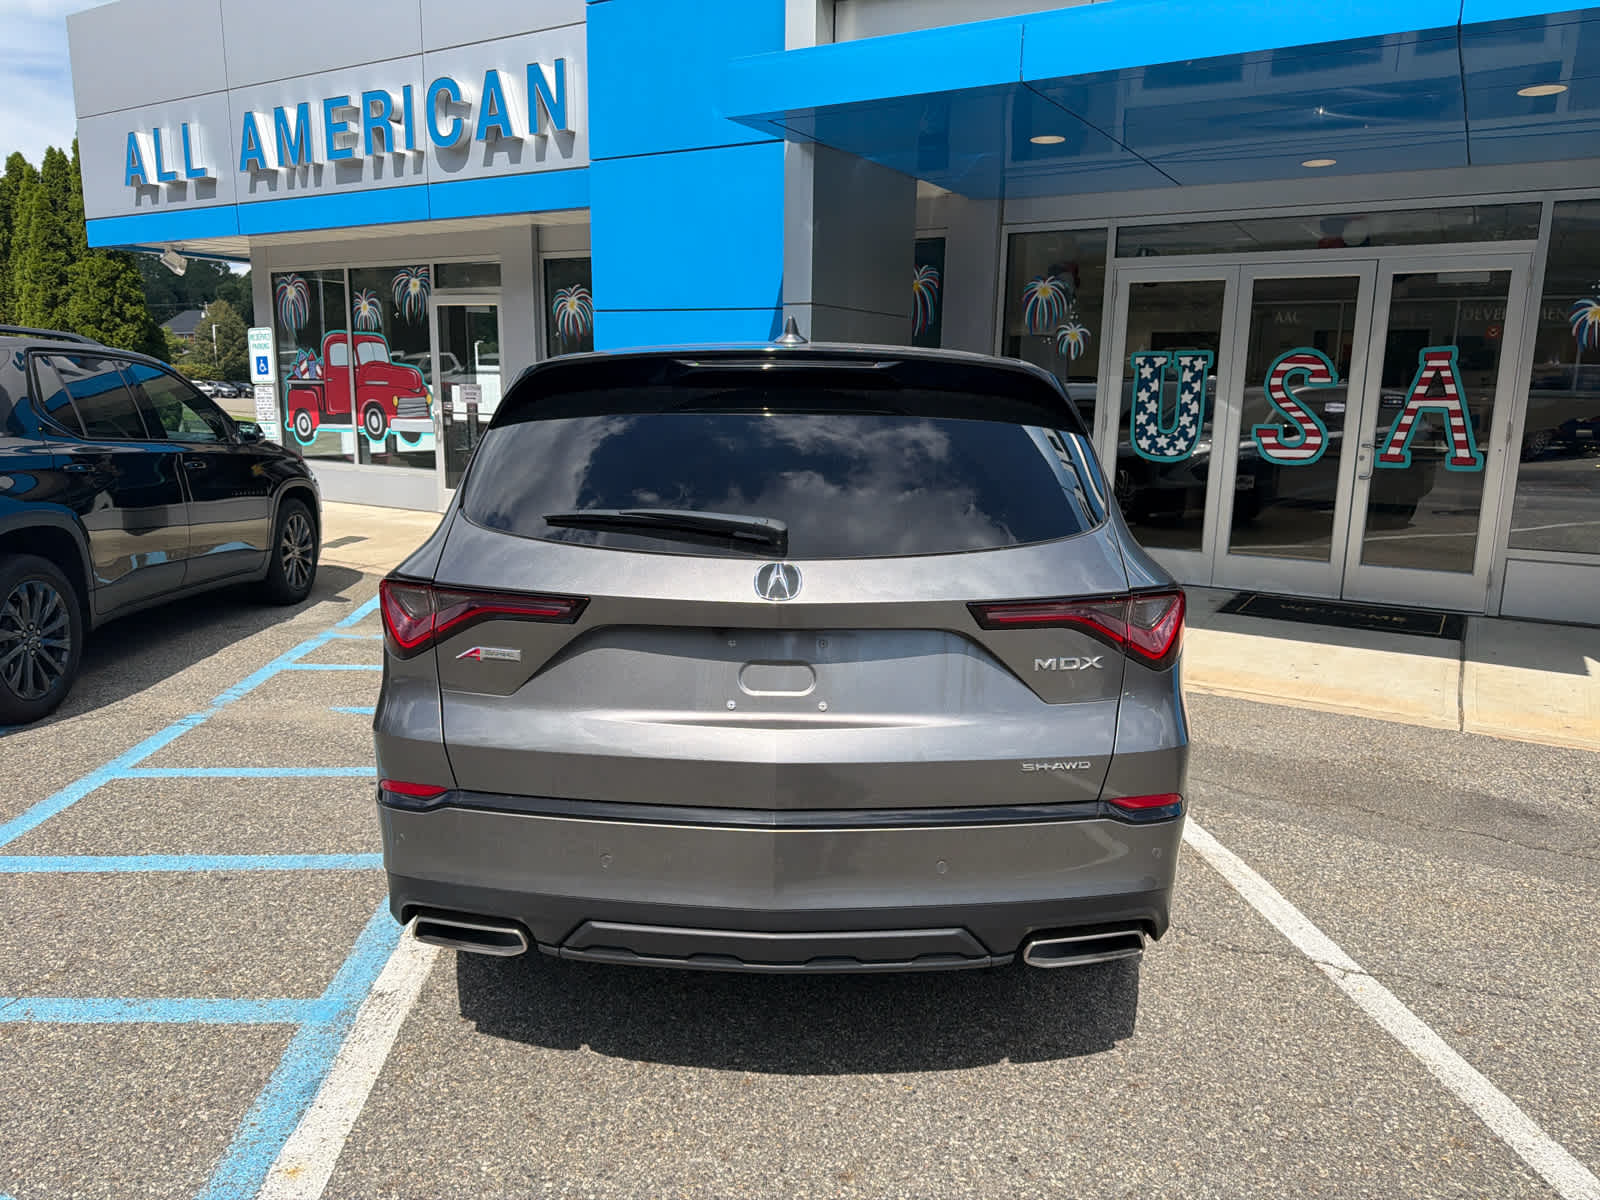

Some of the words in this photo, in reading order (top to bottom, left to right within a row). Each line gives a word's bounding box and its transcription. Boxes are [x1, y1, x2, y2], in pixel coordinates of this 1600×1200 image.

[125, 122, 209, 187] ALL
[239, 57, 569, 172] AMERICAN
[1034, 655, 1105, 672] MDX
